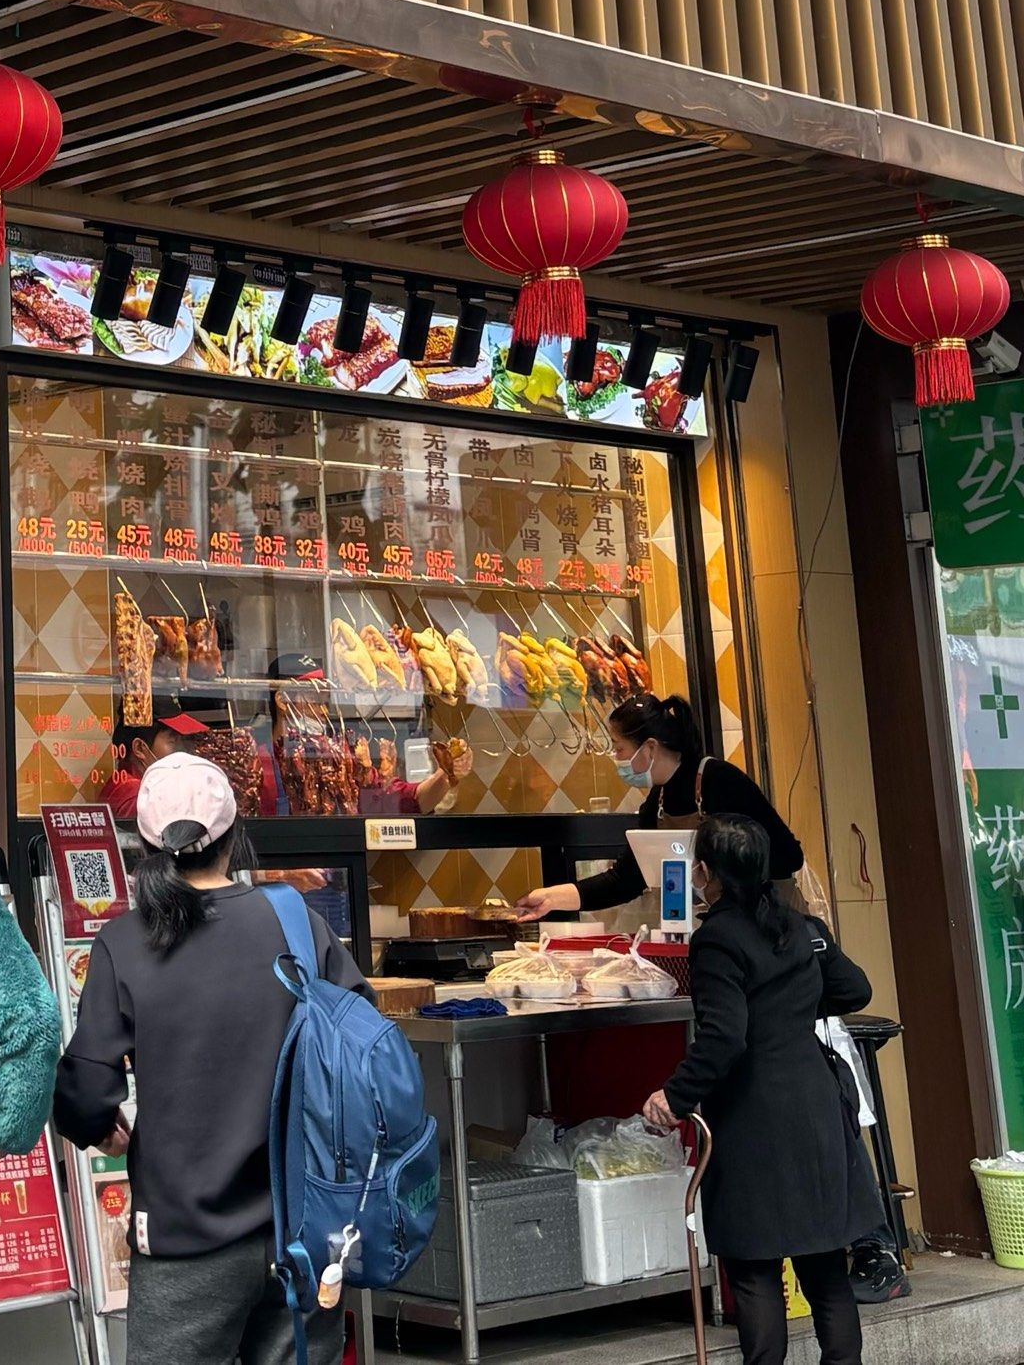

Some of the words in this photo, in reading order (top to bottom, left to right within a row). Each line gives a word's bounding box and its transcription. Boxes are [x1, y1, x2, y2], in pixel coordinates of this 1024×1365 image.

[66, 519, 105, 542] 25元
[116, 525, 153, 546] 45元
[210, 531, 243, 554] 45元
[383, 545, 414, 566] 45元
[474, 552, 505, 573] 42元
